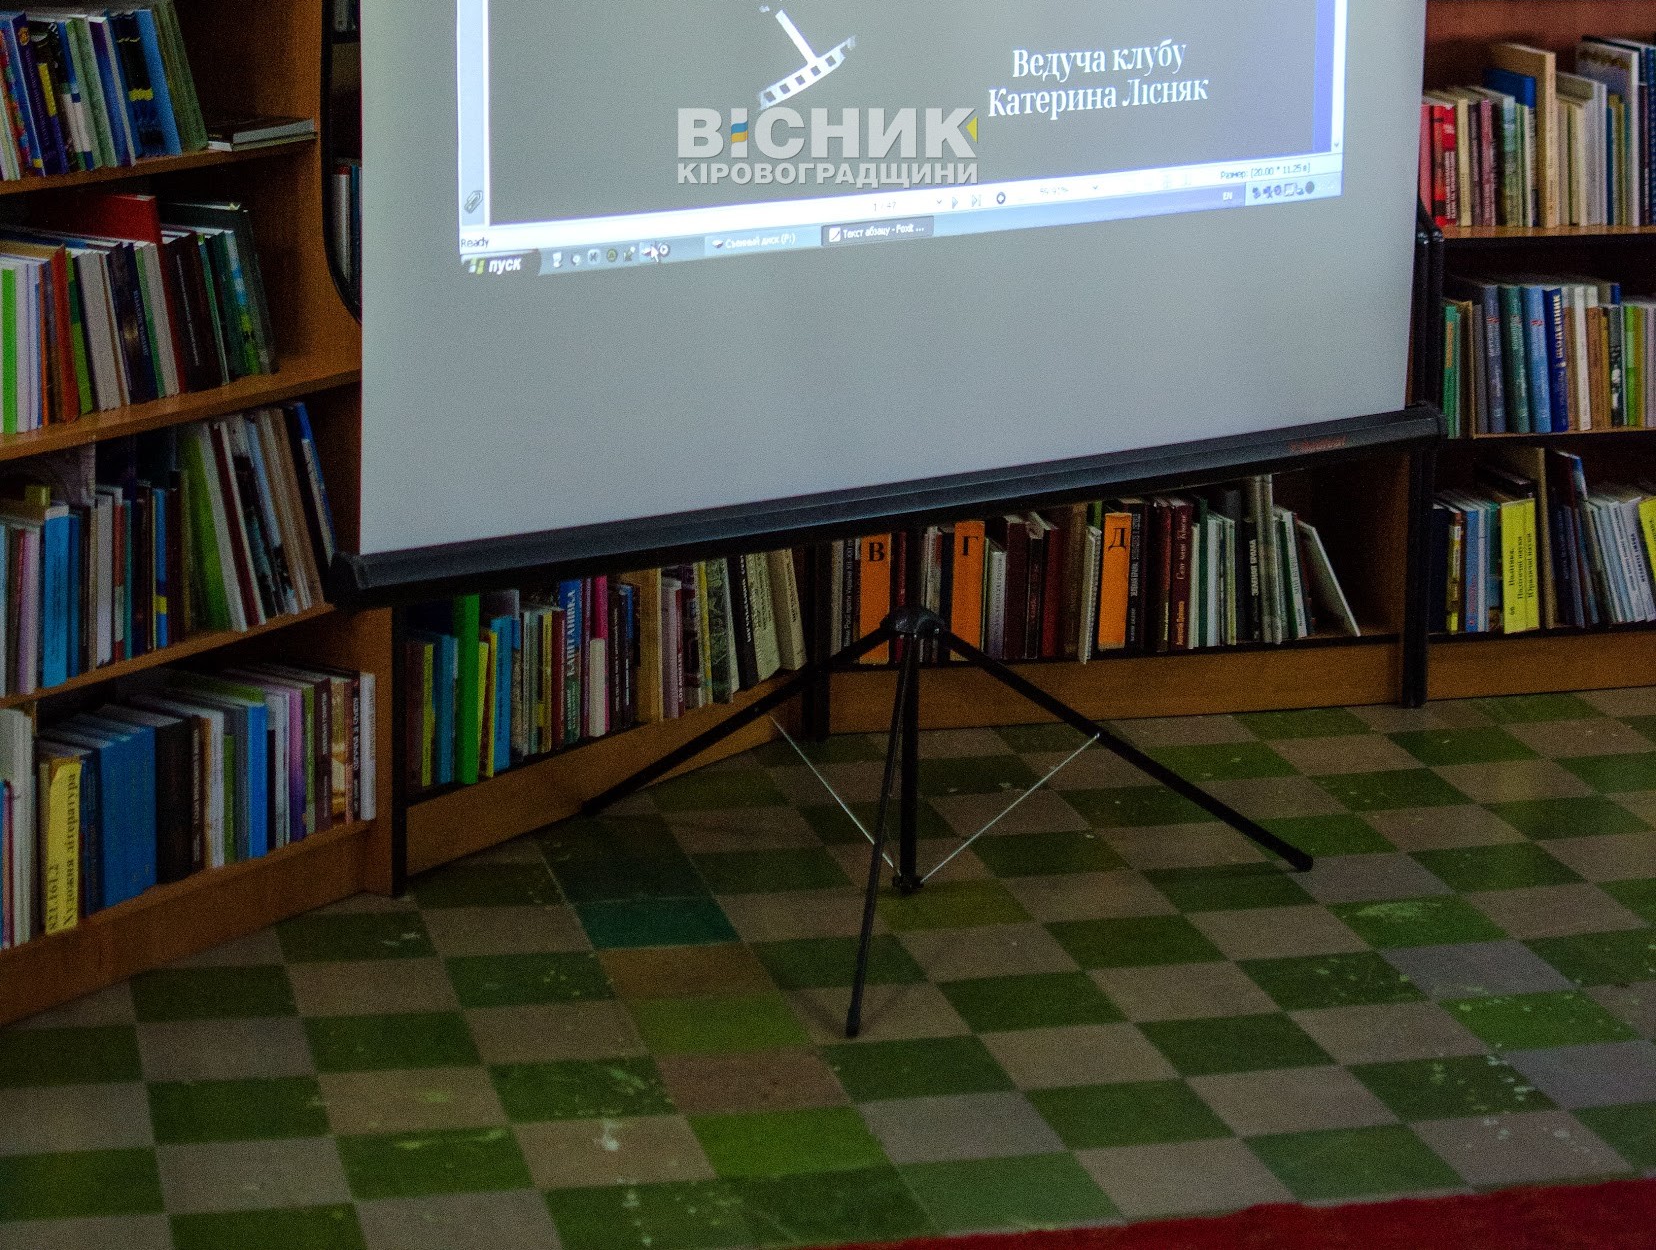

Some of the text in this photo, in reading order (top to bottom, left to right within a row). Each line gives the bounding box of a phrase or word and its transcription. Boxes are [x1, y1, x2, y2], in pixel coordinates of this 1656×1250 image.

[1012, 38, 1187, 82] Ведуча клубу
[988, 76, 1210, 121] Катерина Лісняк
[460, 236, 489, 250] Ready
[843, 226, 864, 239] Текст
[488, 255, 522, 275] пуск
[1552, 294, 1564, 359] ЩОДЕННИК
[963, 535, 979, 555] Г
[1108, 527, 1127, 551] Д
[868, 541, 885, 562] В
[566, 589, 577, 678] КАПІТАНІВКА
[63, 773, 77, 926] Художня література
